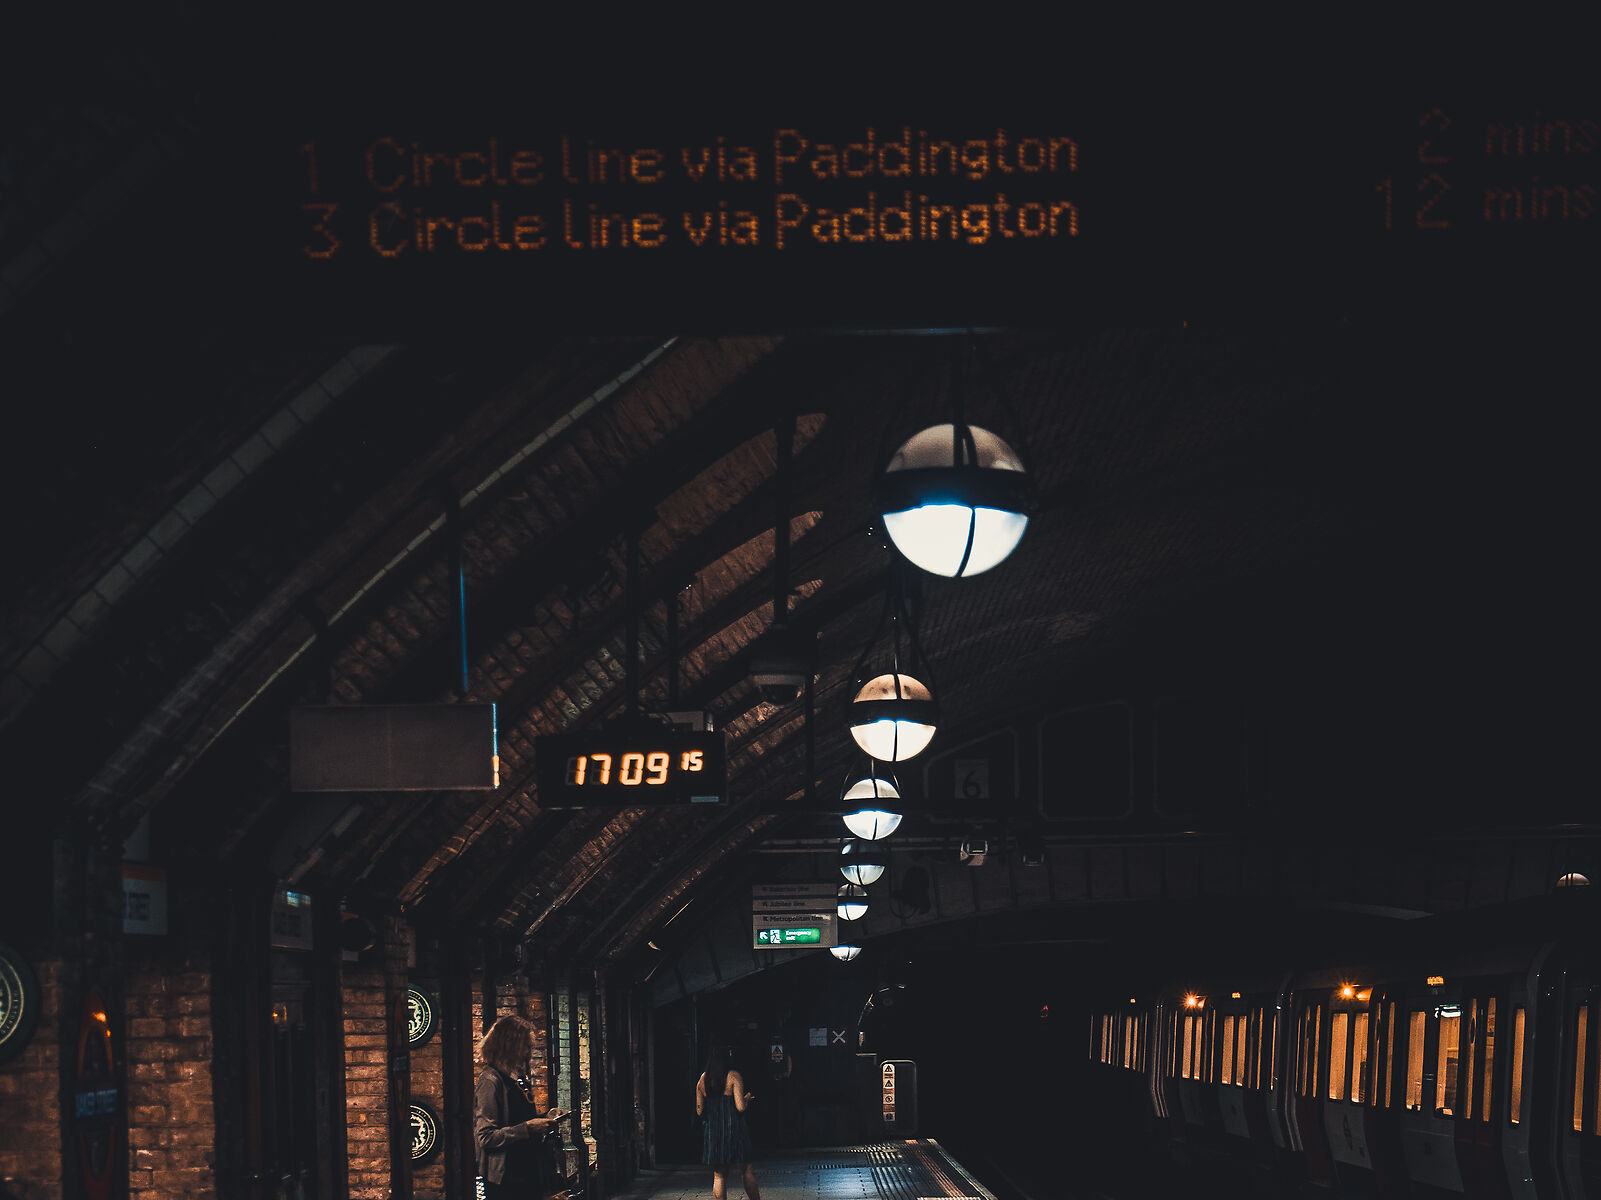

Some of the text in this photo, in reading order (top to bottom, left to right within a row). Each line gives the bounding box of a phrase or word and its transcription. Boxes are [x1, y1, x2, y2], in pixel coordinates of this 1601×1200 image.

[302, 126, 1081, 194] 1 Circle line via Paddington
[1417, 105, 1453, 165] 2
[302, 190, 1081, 259] 3 Circle line via Paddington
[1484, 175, 1598, 222] mins
[679, 749, 704, 772] 15
